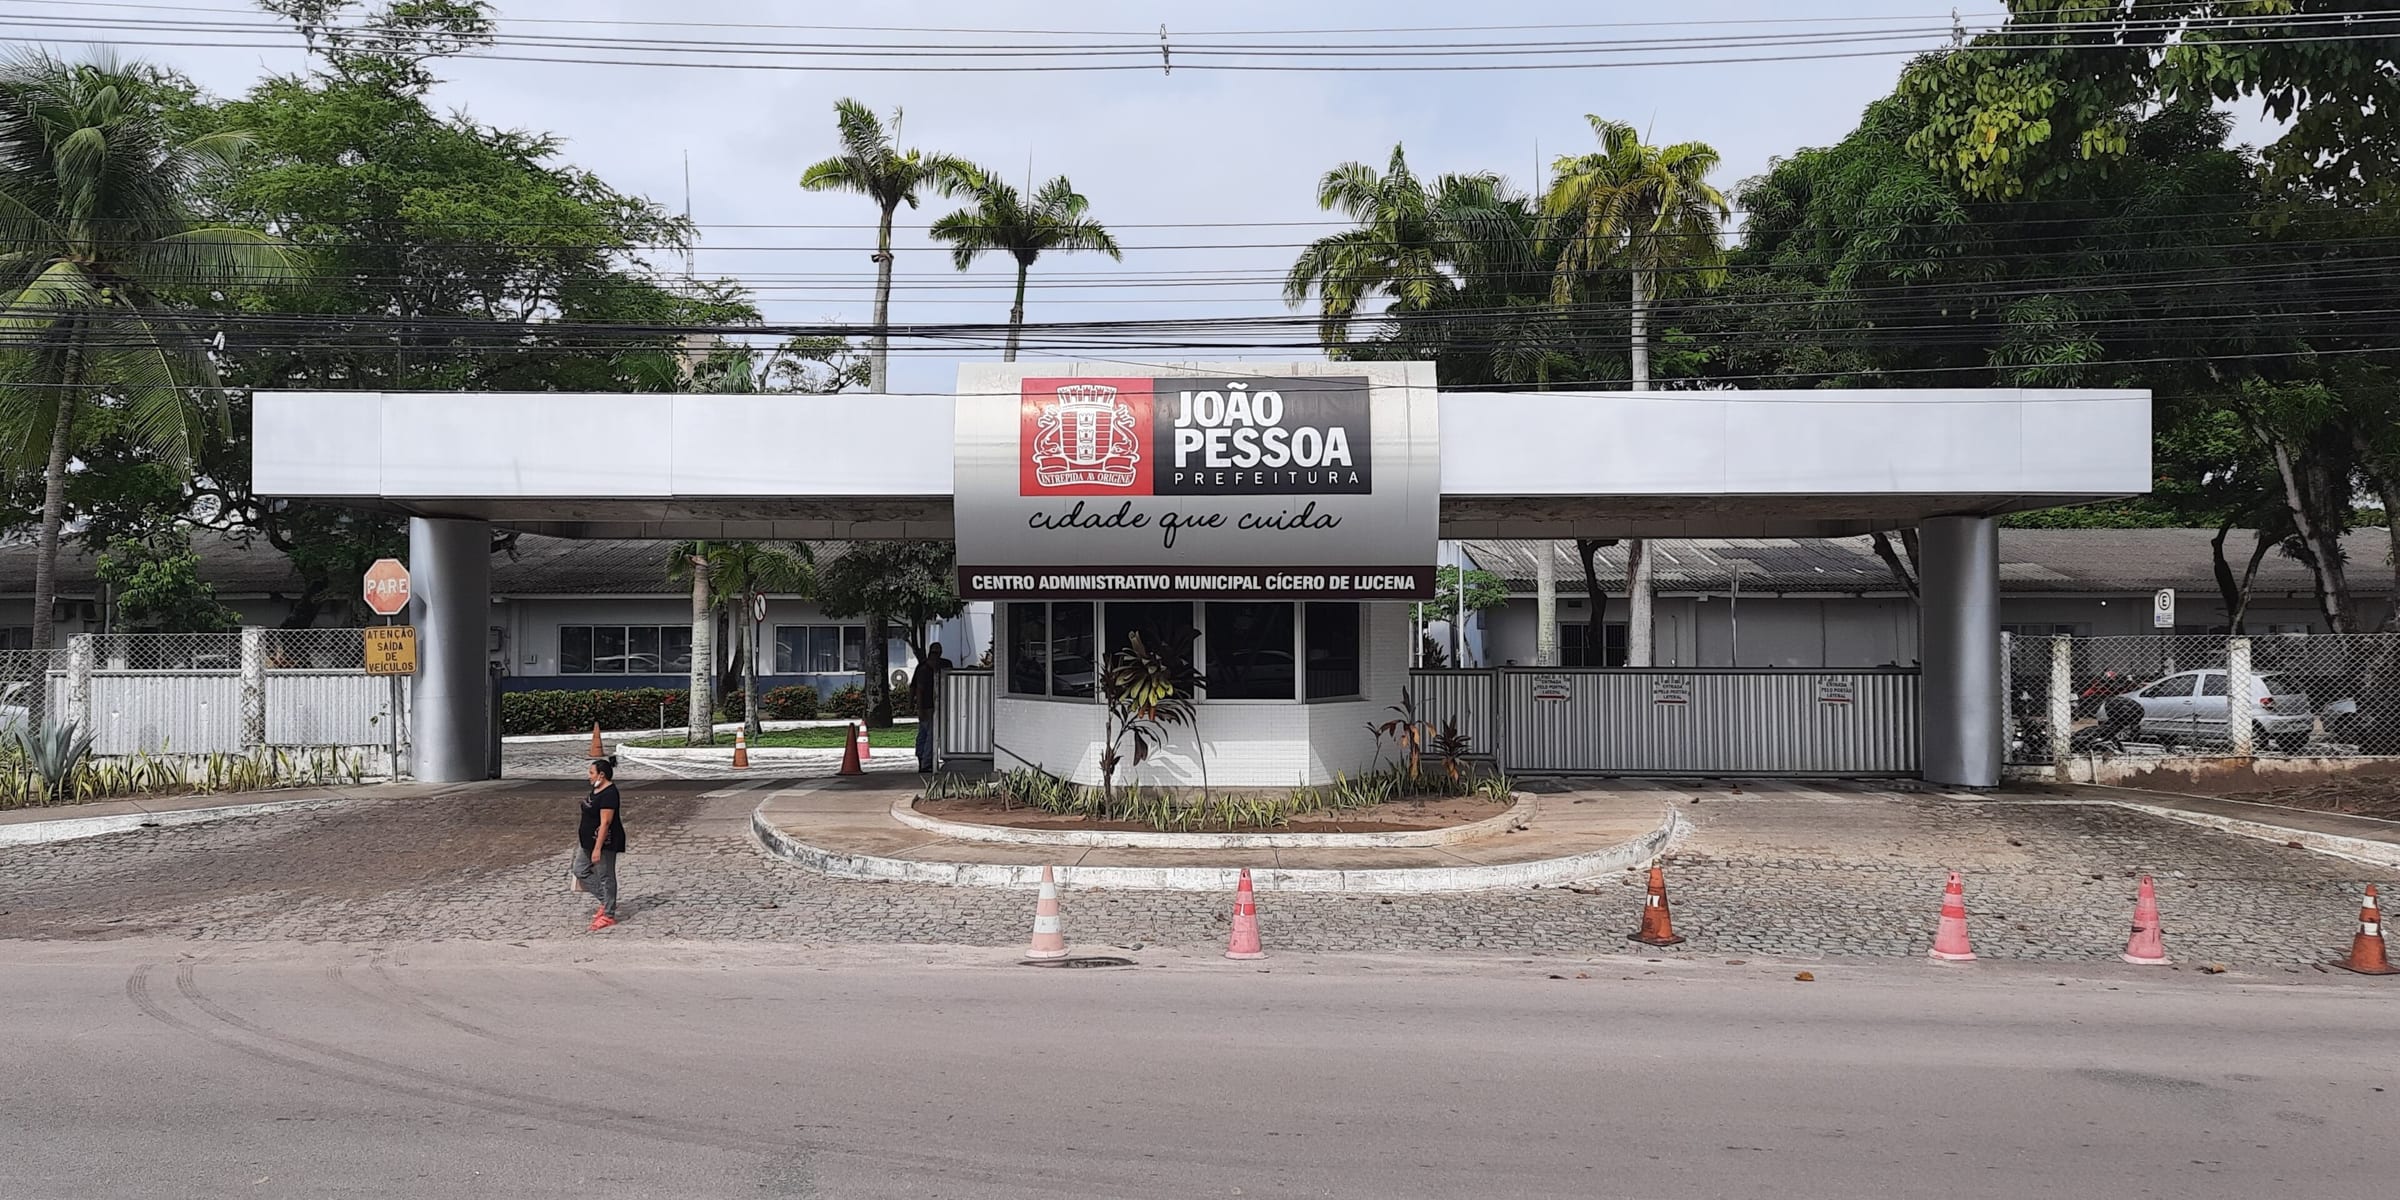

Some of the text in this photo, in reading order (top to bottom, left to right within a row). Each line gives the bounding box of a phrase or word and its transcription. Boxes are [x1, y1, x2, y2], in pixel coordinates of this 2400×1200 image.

[1174, 381, 1284, 428] JOÃO
[1174, 426, 1353, 468] PESSOA
[1041, 472, 1083, 484] INTREPIDA
[1097, 473, 1132, 484] ORIGINE
[1174, 470, 1360, 485] PREFEITURA
[1028, 500, 1342, 549] cidade que cuida
[367, 579, 408, 594] PARE
[972, 572, 1415, 590] CENTRO ADMINISTRATIVO MUNICIPAL CÍCERO DE LUCENA
[367, 629, 413, 640] ATENÇÃO
[377, 640, 404, 651] SAÍDA
[385, 652, 398, 662] DE
[369, 662, 414, 672] VEÍCULOS
